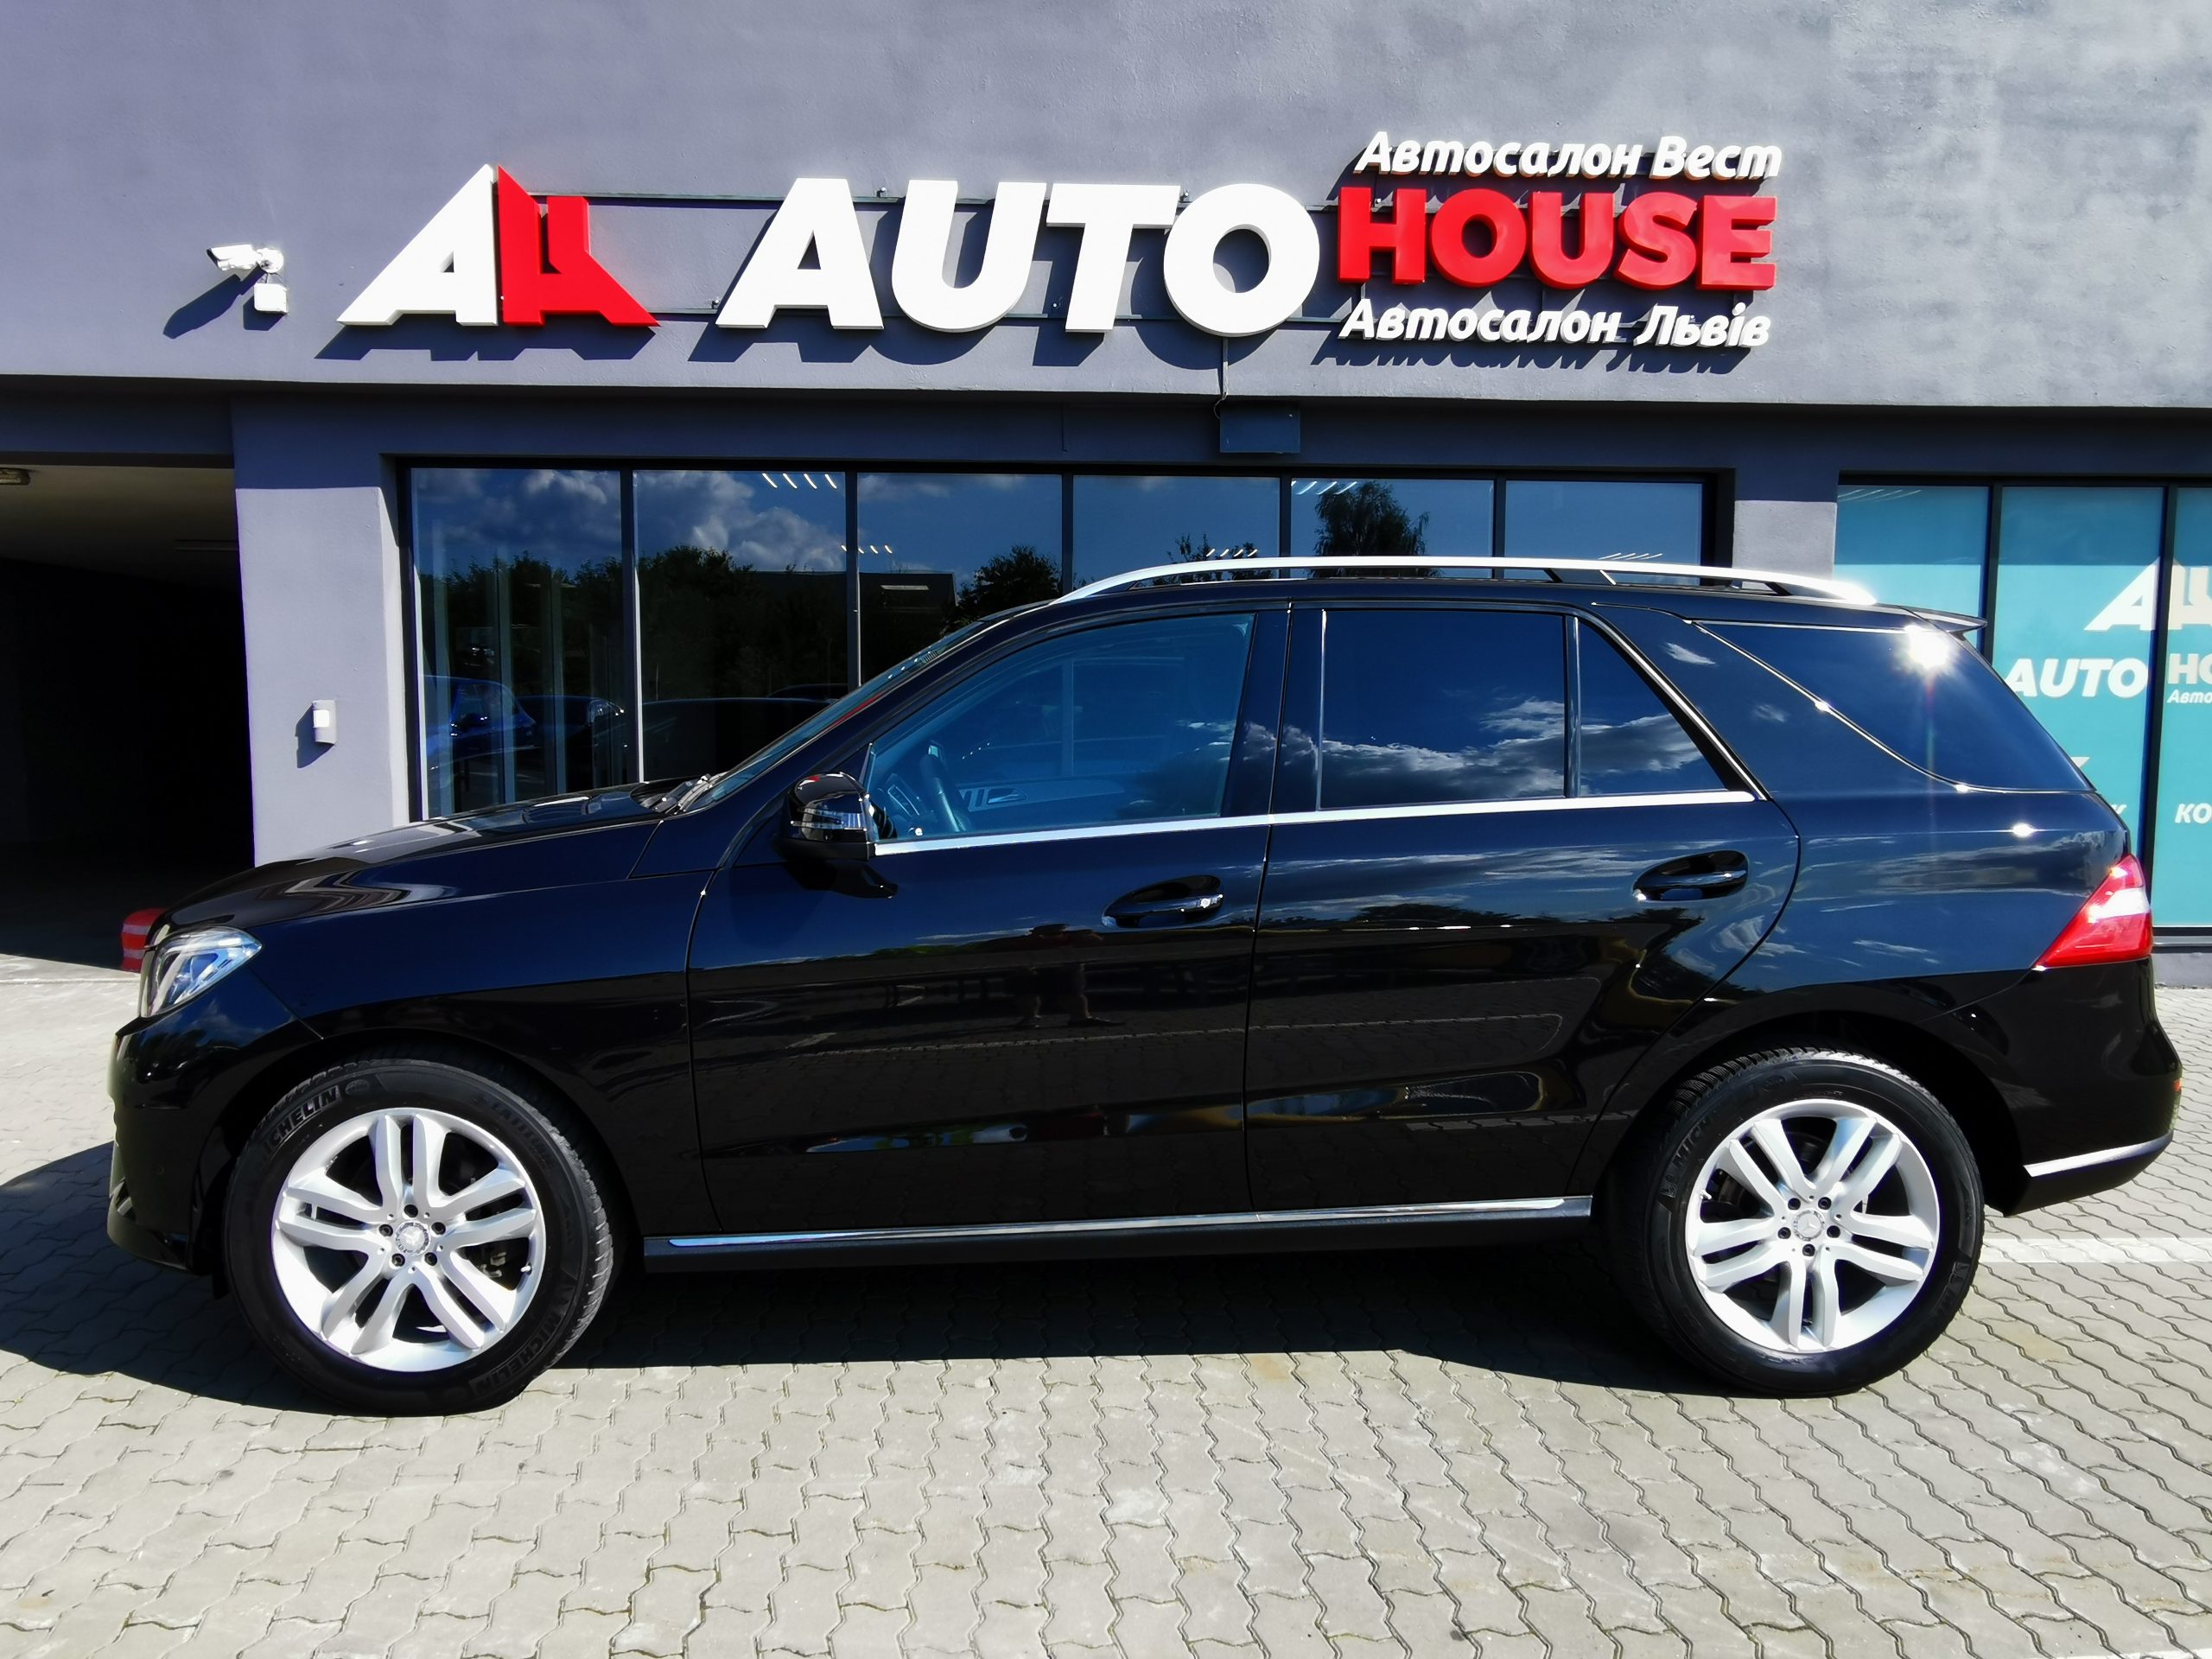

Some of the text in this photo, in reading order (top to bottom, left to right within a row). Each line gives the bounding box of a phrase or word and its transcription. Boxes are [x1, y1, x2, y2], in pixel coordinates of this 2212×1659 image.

[1354, 131, 1783, 180] Автосалон Вест
[715, 178, 1778, 337] AUTO HOUSE
[1338, 298, 1772, 347] Автосалон Львів
[2004, 658, 2149, 698] AUTO
[258, 1086, 338, 1166] ICHELIN
